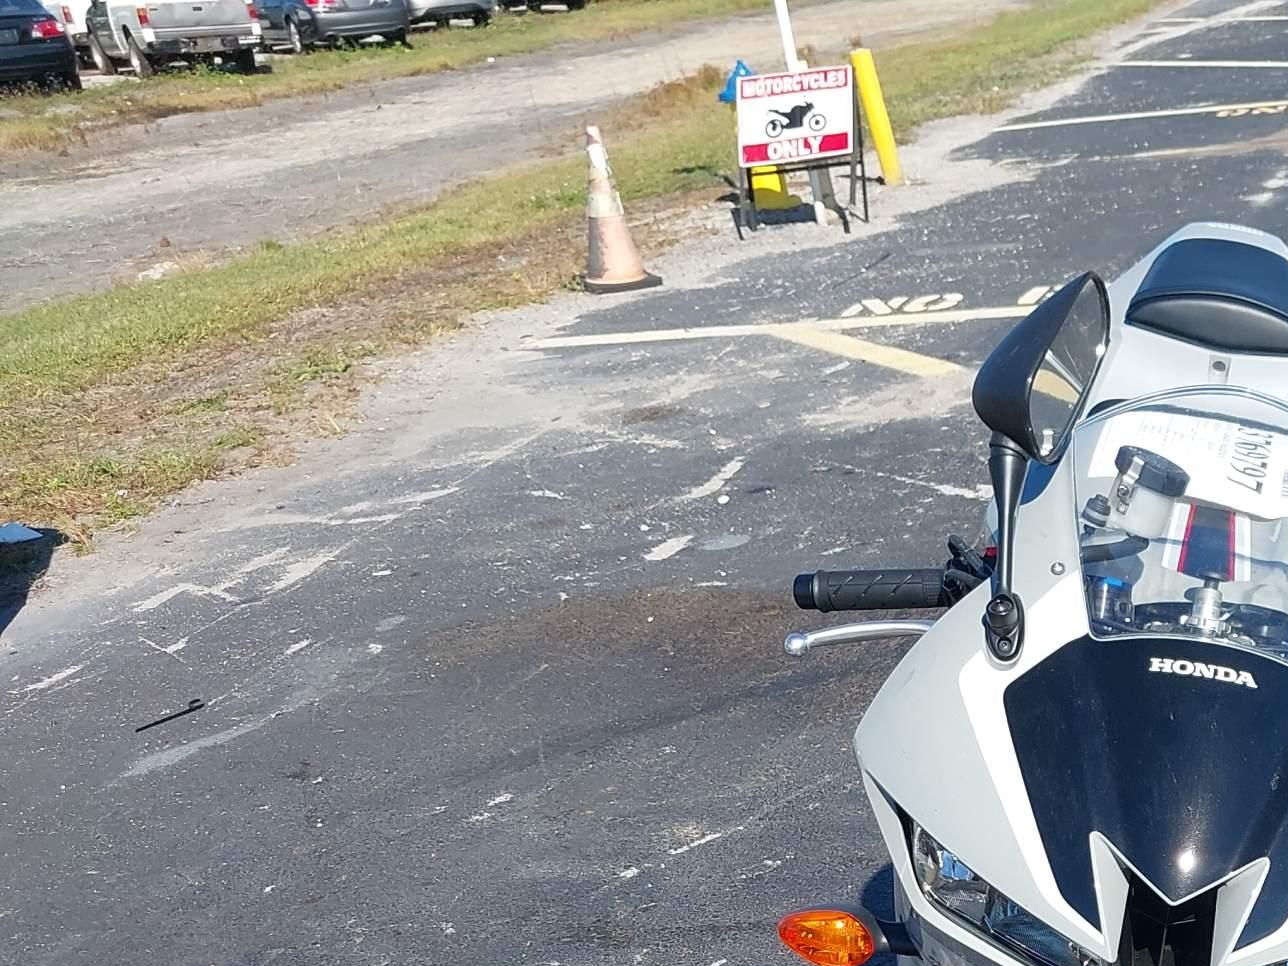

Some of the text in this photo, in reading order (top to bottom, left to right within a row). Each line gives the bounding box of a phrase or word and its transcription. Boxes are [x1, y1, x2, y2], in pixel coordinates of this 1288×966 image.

[742, 69, 847, 98] MOTORCYCLES
[767, 136, 824, 160] ONLY
[841, 293, 964, 317] NO
[1149, 657, 1258, 688] HONDA
